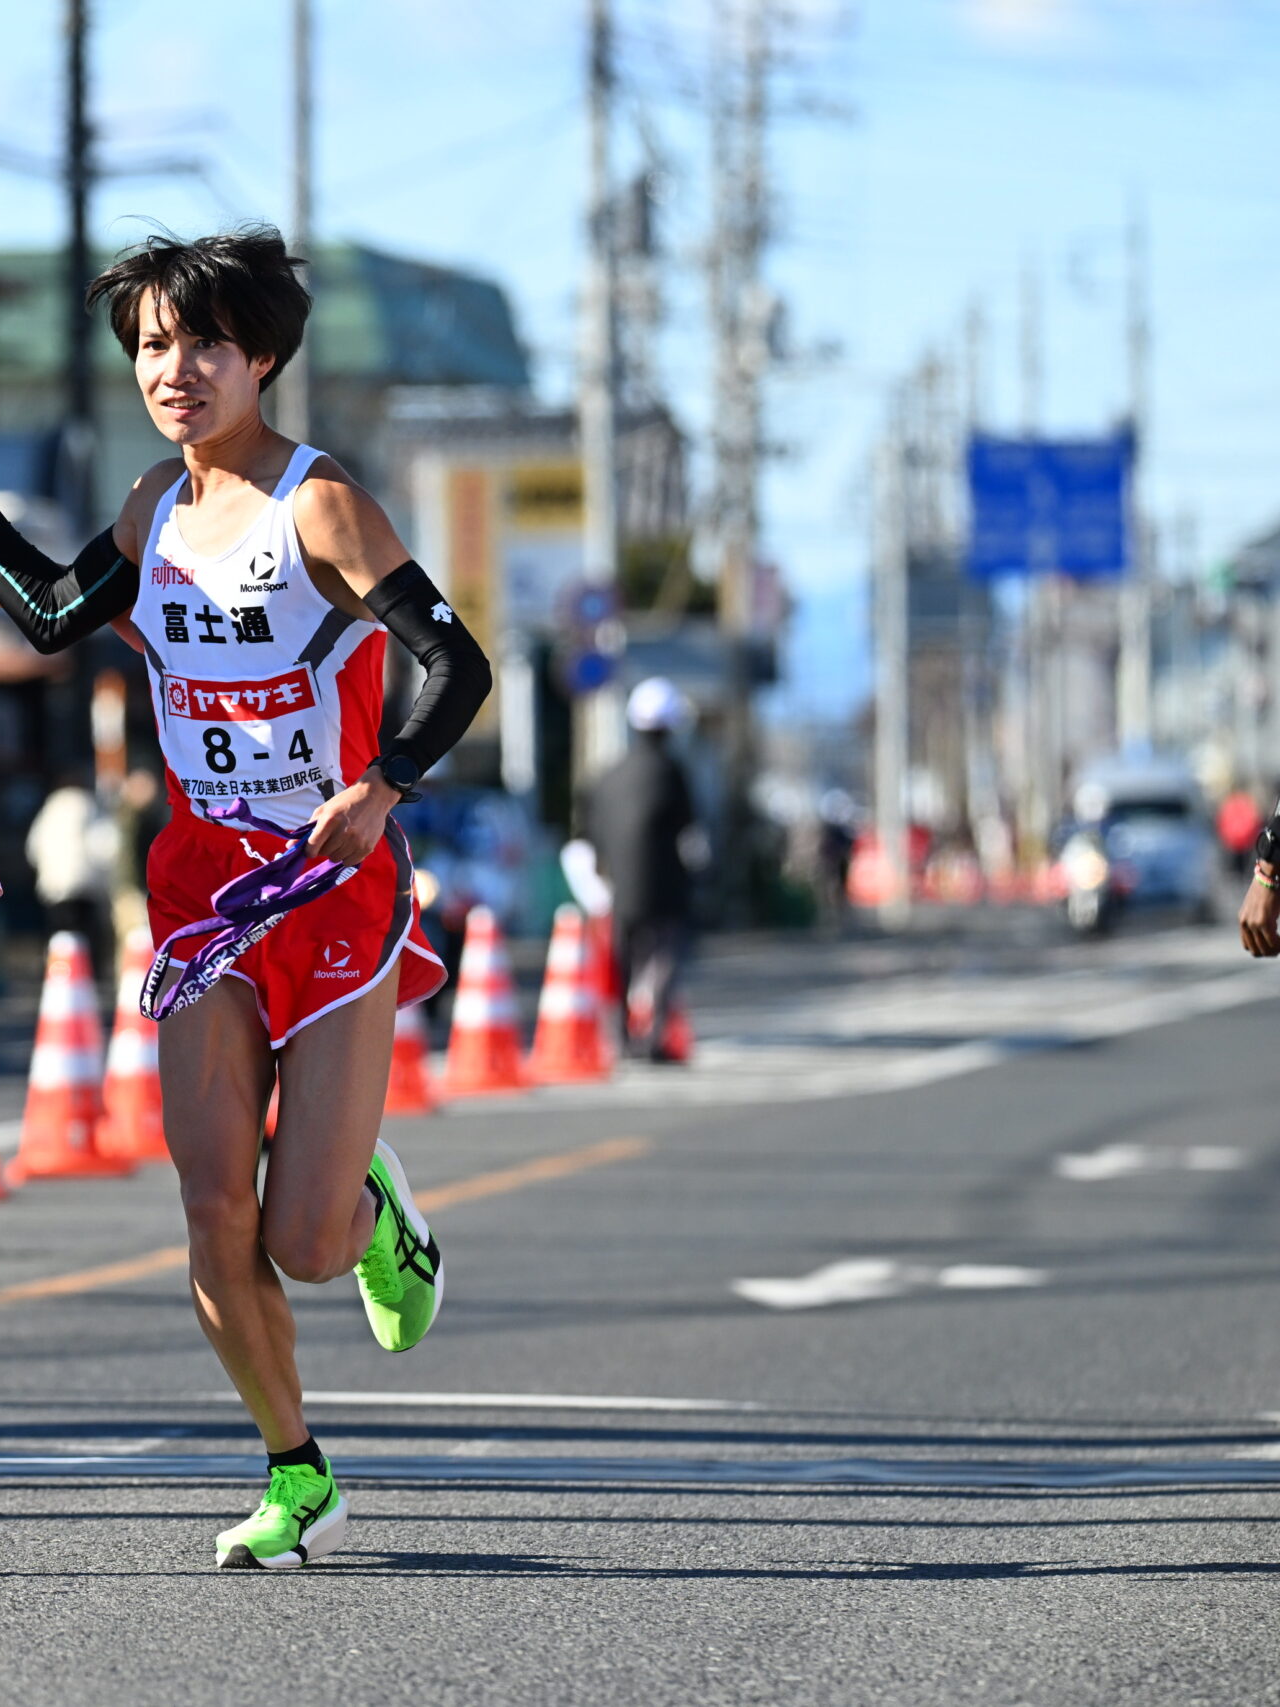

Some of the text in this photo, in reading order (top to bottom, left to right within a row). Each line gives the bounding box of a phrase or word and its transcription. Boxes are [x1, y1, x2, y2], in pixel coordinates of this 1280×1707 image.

[152, 554, 196, 591] FUJITSU
[161, 602, 274, 645] 富士通
[193, 681, 303, 713] ヤマザキ
[180, 766, 323, 797] 第70回全日本実業団駅伝
